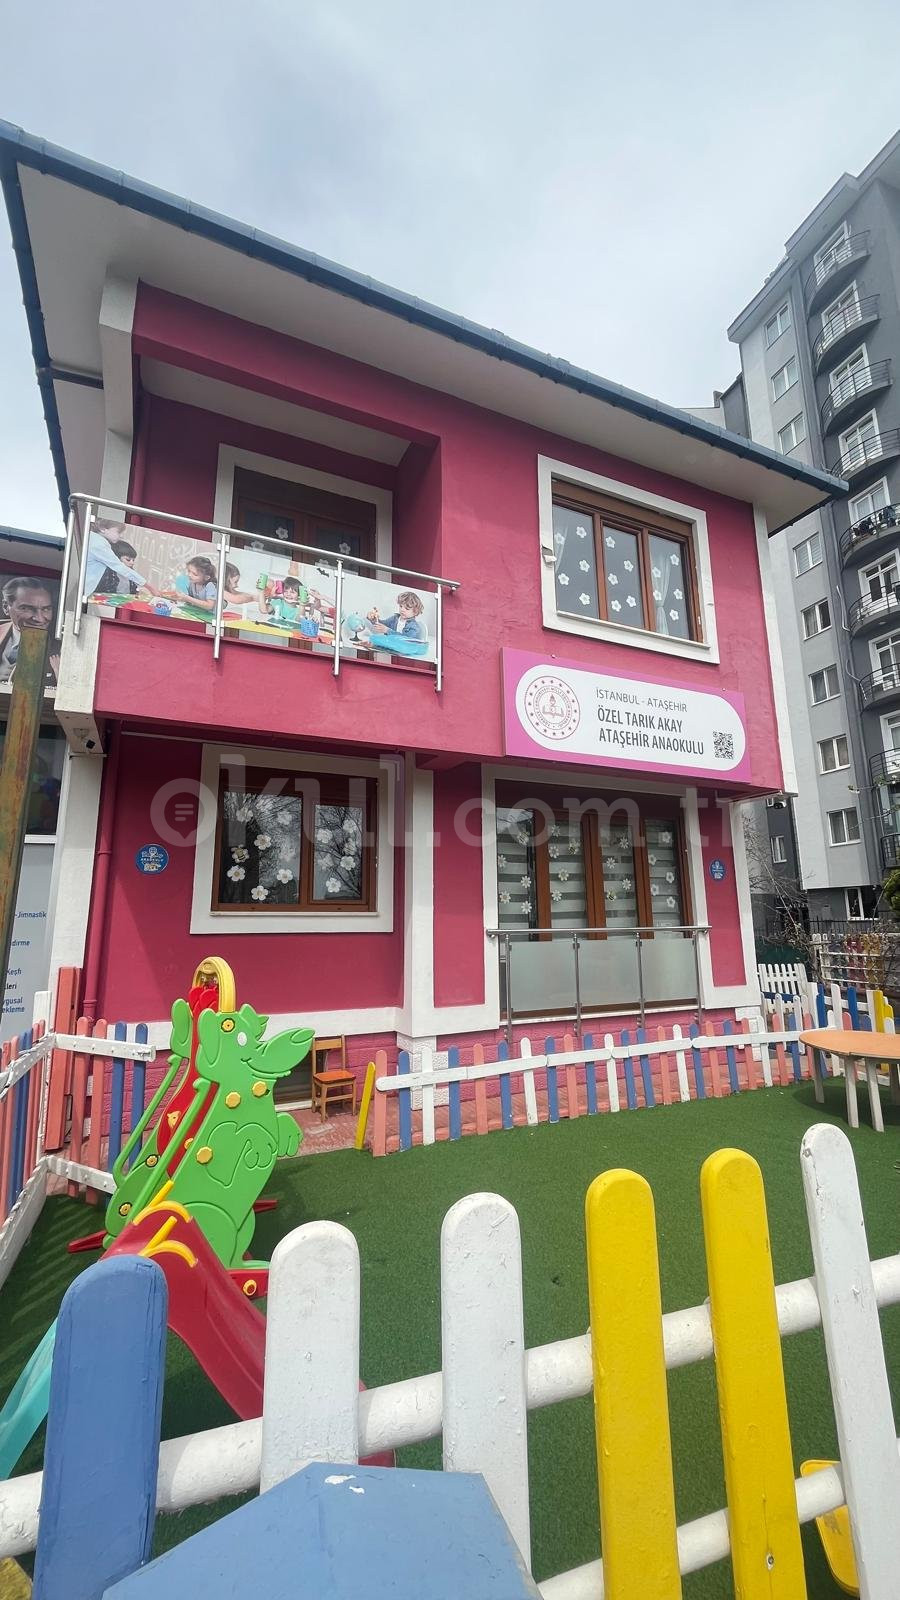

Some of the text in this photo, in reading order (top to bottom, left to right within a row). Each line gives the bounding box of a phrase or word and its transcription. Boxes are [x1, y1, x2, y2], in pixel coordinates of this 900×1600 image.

[596, 687, 640, 705] İSTANBUL
[647, 697, 688, 713] ATAŞEHİR
[597, 705, 683, 733] ÖZEL TARIK AKAY
[599, 728, 704, 755] ATAŞEHİR ANAOKULU
